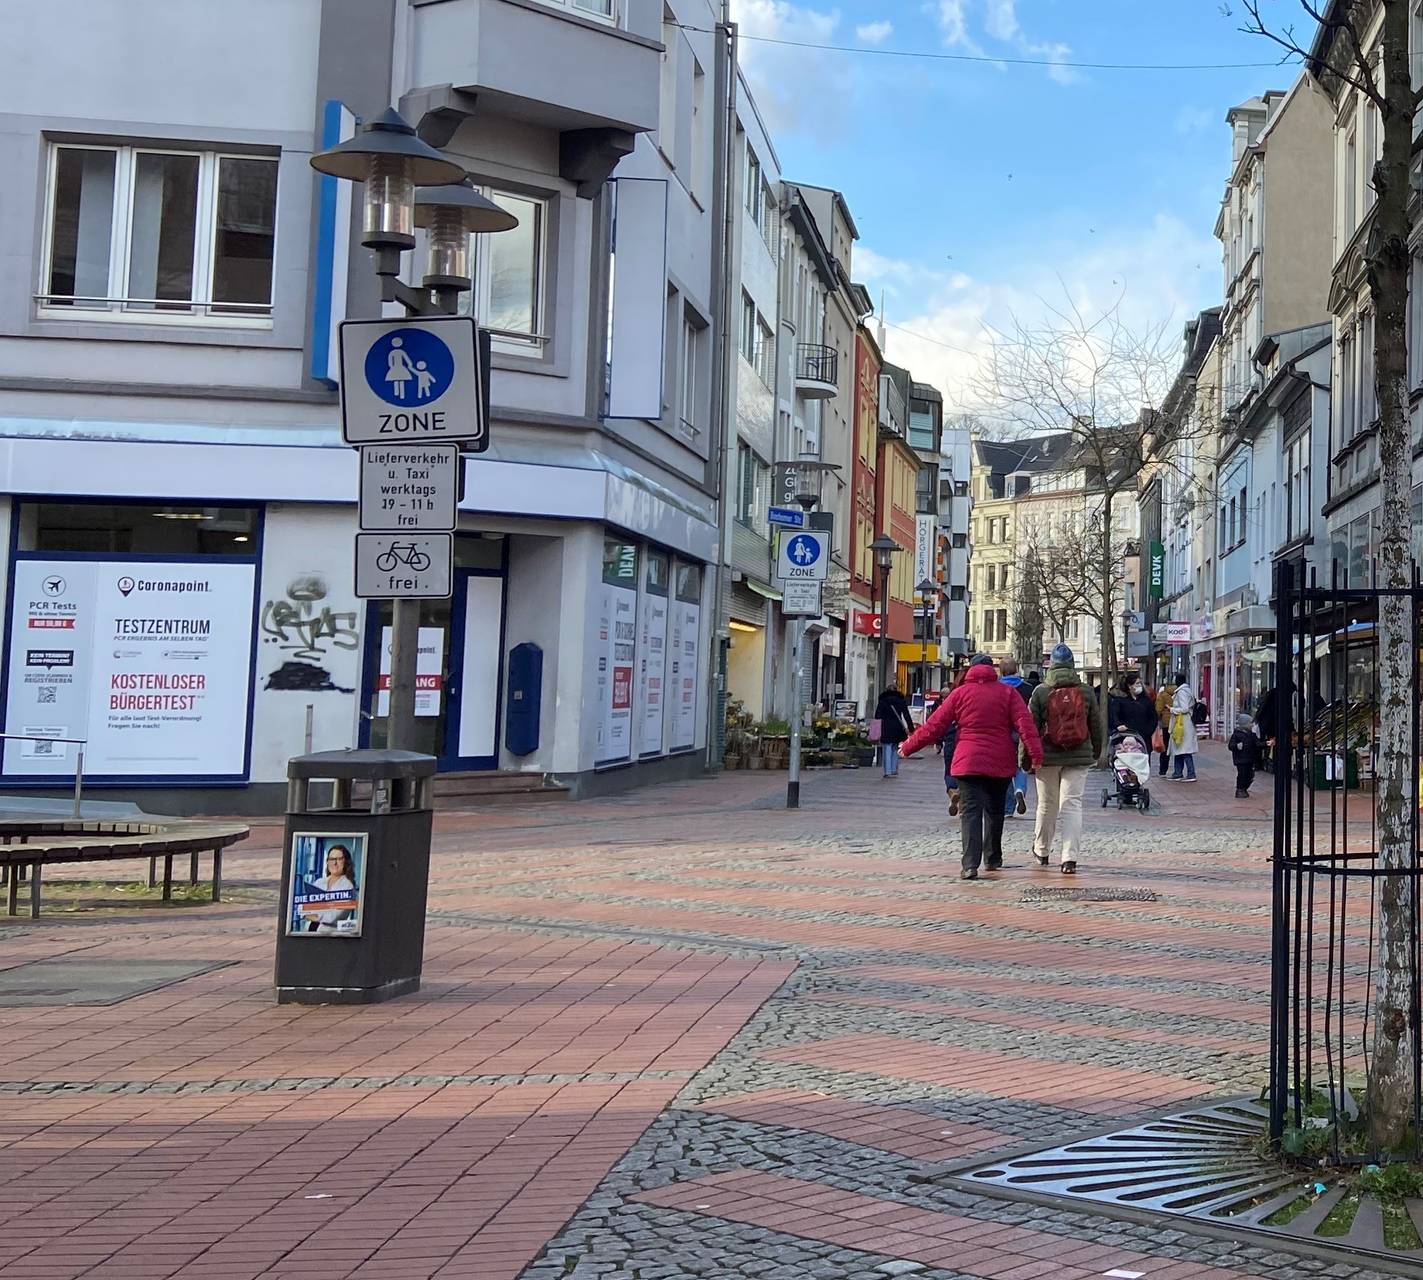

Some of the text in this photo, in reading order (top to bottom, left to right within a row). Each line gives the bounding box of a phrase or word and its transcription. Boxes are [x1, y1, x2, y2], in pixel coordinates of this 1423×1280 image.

[378, 412, 446, 433] ZONE
[367, 451, 450, 465] Lieferverkehr
[388, 467, 429, 479] u. Taxi
[380, 483, 436, 497] werktags
[411, 499, 422, 510] 11
[427, 499, 434, 510] h
[398, 514, 418, 525] frei
[790, 568, 815, 576] ZONE
[1152, 555, 1162, 585] DEVK
[137, 580, 209, 593] Coronapoint
[389, 575, 418, 589] frei
[29, 601, 77, 610] PCR Tests
[114, 619, 210, 634] TESTZENTRUM
[111, 673, 206, 689] KOSTENLOSER
[110, 691, 196, 710] BÜRGERTEST
[294, 894, 308, 903] DIE
